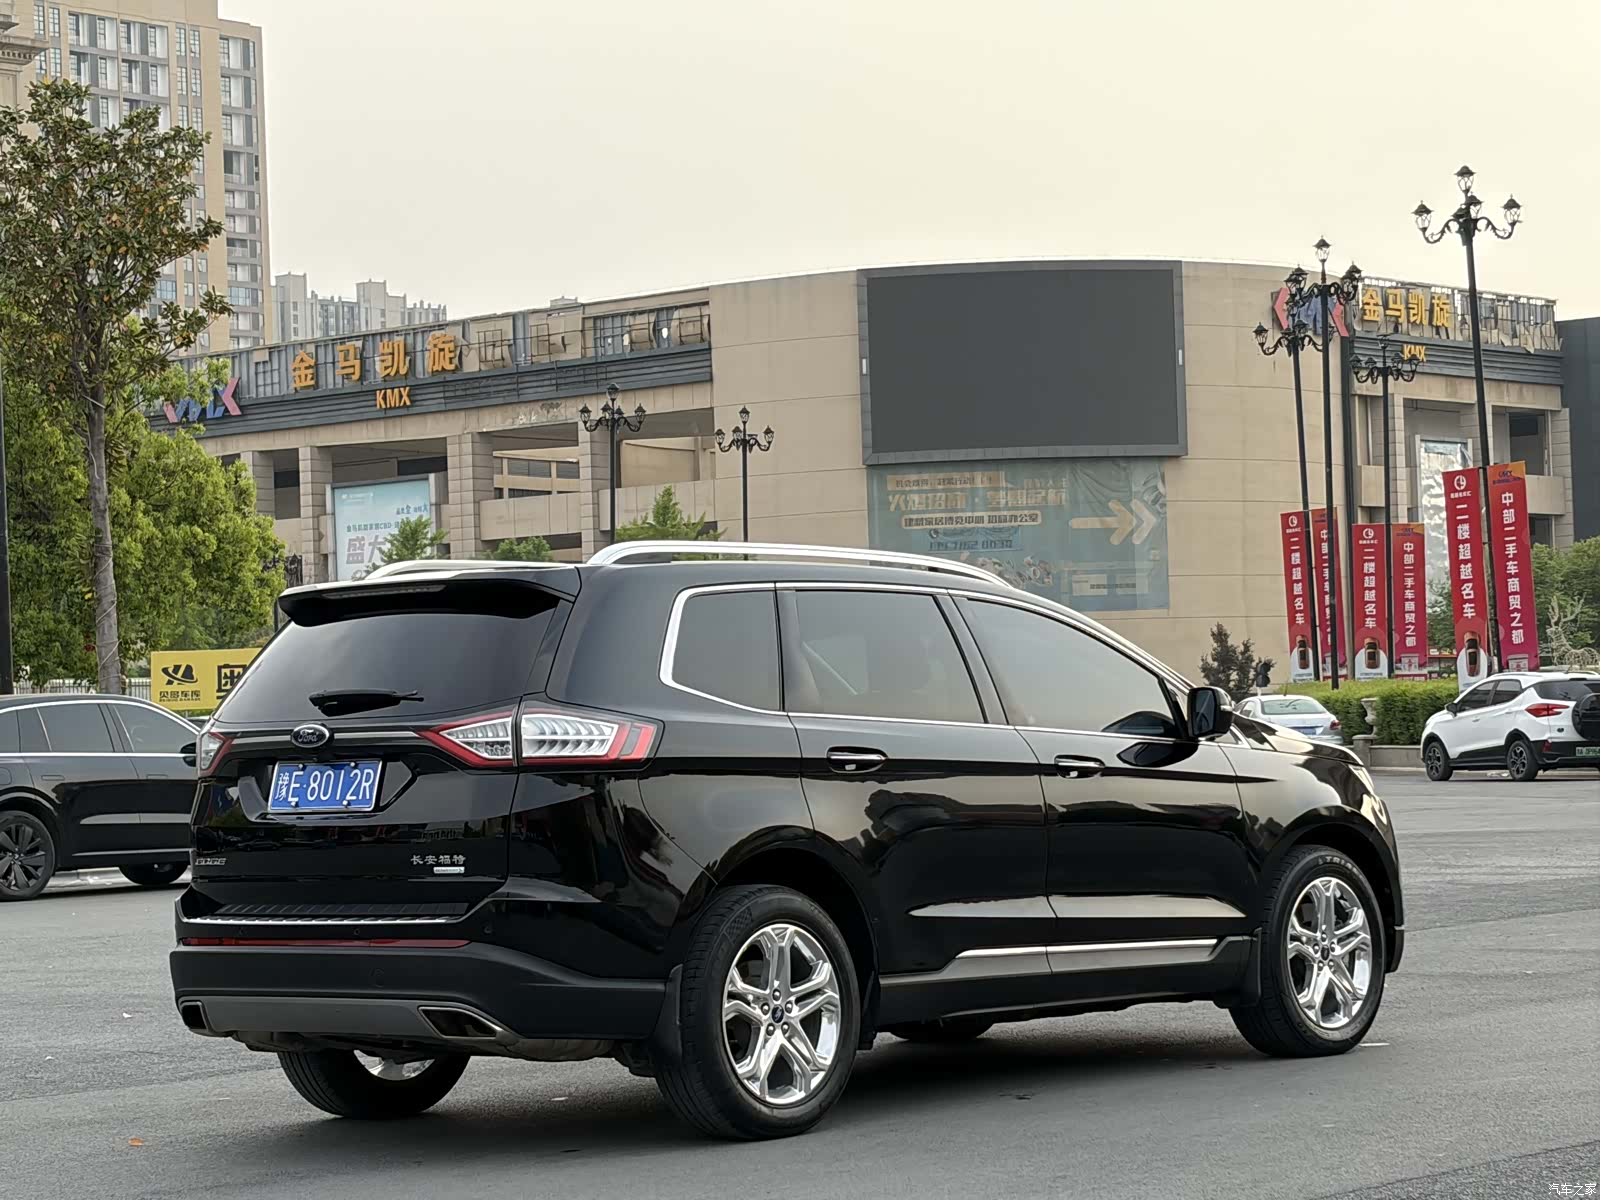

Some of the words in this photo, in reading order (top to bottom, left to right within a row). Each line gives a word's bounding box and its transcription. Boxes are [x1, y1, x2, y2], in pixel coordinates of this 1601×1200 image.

[1363, 288, 1452, 327] 金马凯旋
[290, 332, 457, 389] 金马凯旋
[1403, 345, 1427, 361] KMX
[376, 387, 411, 409] KMX
[1290, 538, 1305, 625] 二楼超越名车
[1363, 549, 1377, 629] 二楼超越名车
[1456, 504, 1476, 619] 二楼超越名车
[1501, 492, 1524, 644] 中部二手车商贸之都
[1404, 542, 1417, 647] 中部二手车商贸之都
[297, 729, 319, 742] Ford
[410, 854, 466, 865] 长安福特
